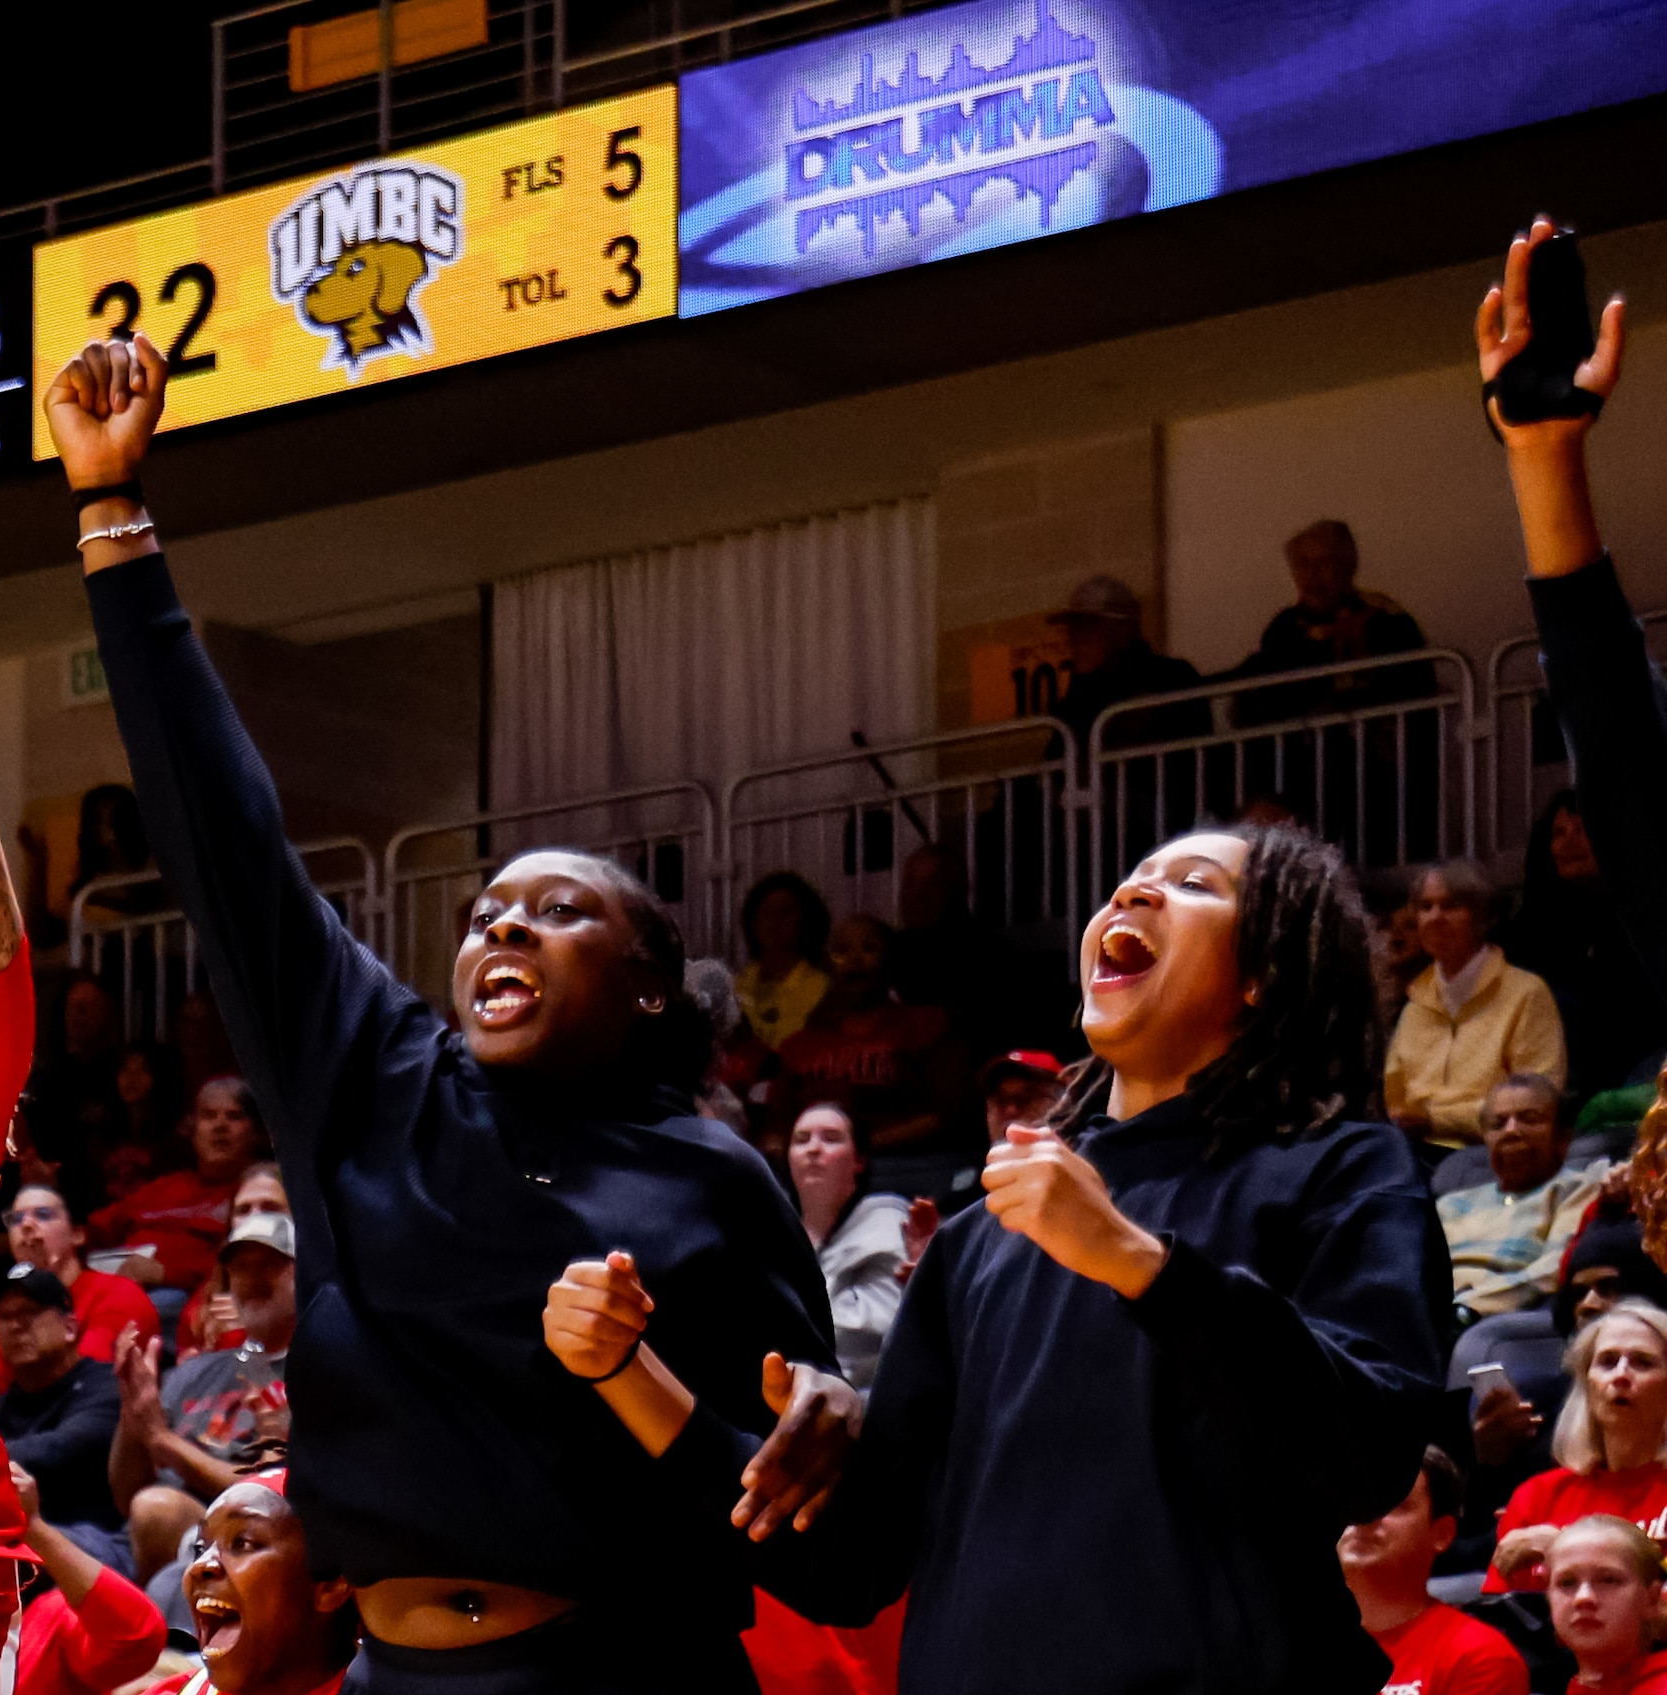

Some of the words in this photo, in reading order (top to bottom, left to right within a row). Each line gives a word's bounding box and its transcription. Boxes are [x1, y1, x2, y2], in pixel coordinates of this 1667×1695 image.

[501, 156, 564, 200] FLS
[604, 125, 643, 198] 5
[784, 69, 1115, 199] DRUMMA
[277, 168, 457, 292] UMBC
[498, 268, 565, 311] TOL
[603, 234, 643, 307] 3
